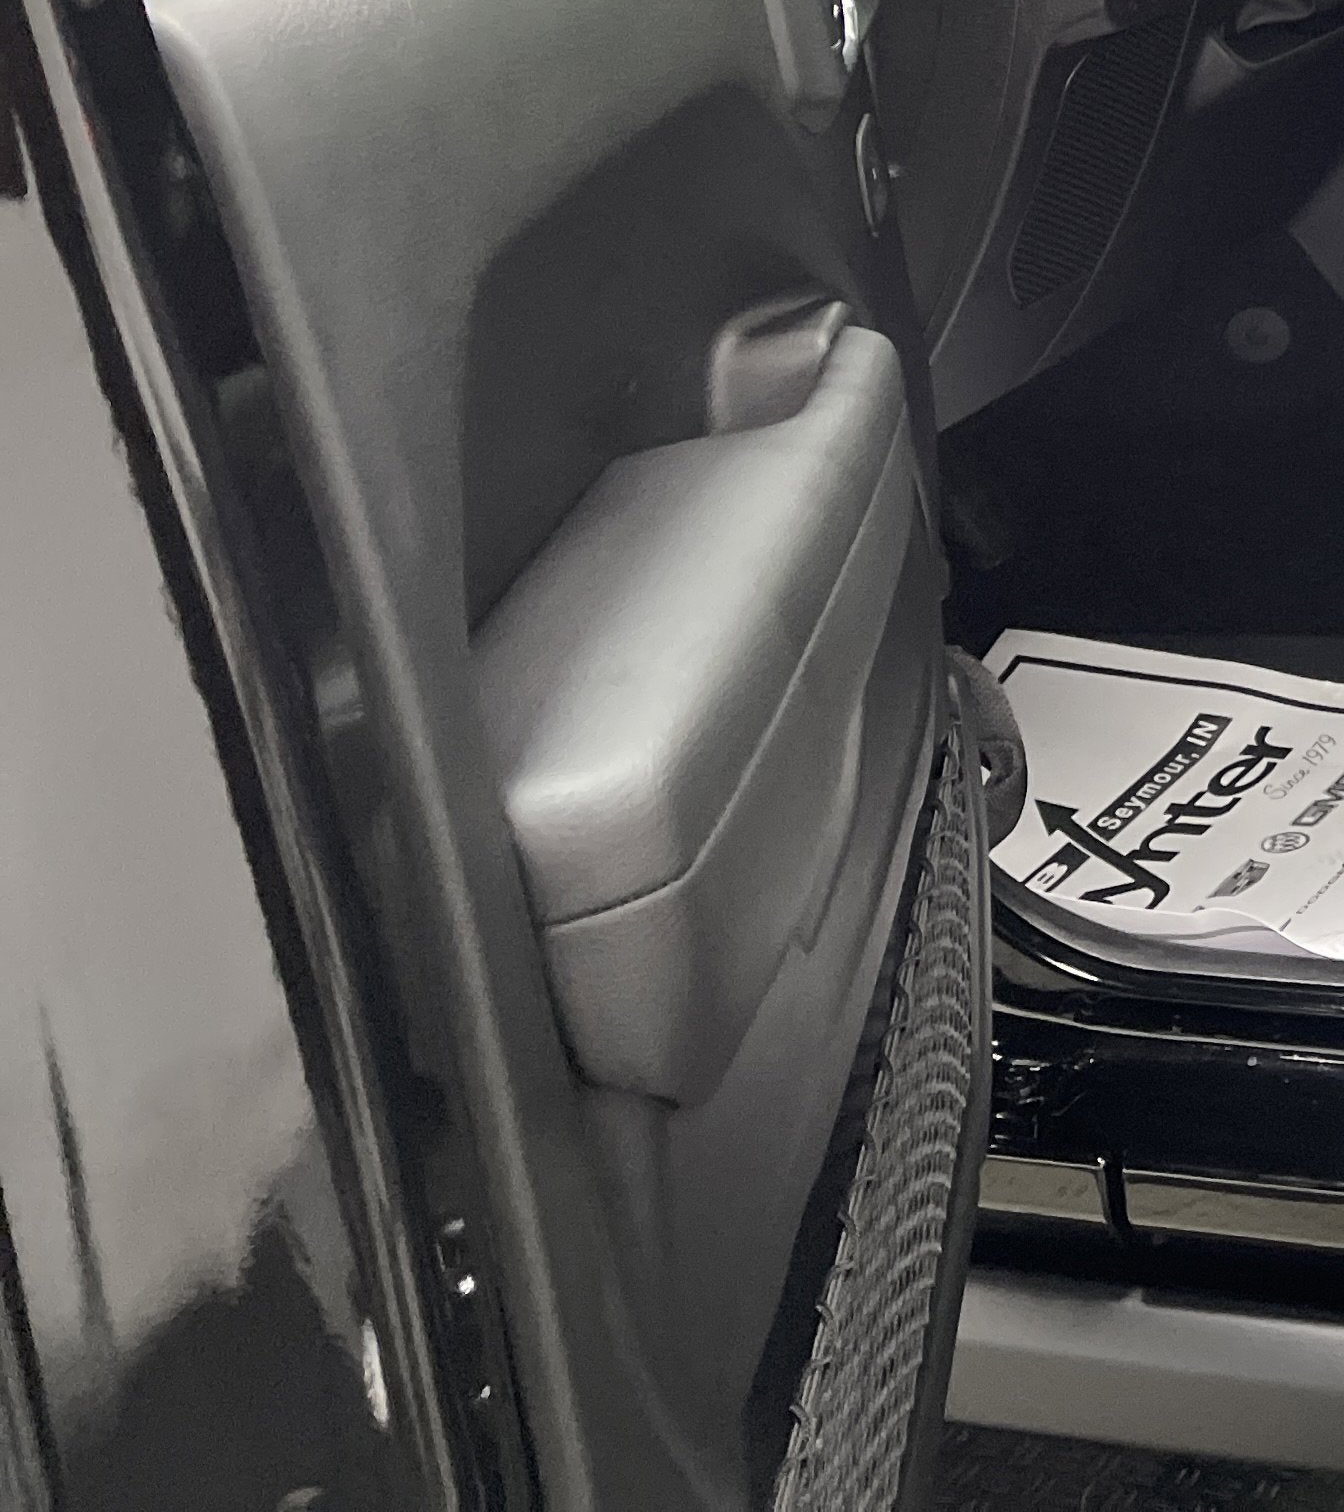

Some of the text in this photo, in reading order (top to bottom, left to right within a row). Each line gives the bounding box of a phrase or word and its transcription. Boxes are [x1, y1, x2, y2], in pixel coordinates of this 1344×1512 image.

[1097, 720, 1219, 831] Seymour, IN
[1263, 734, 1337, 800] Since 1979
